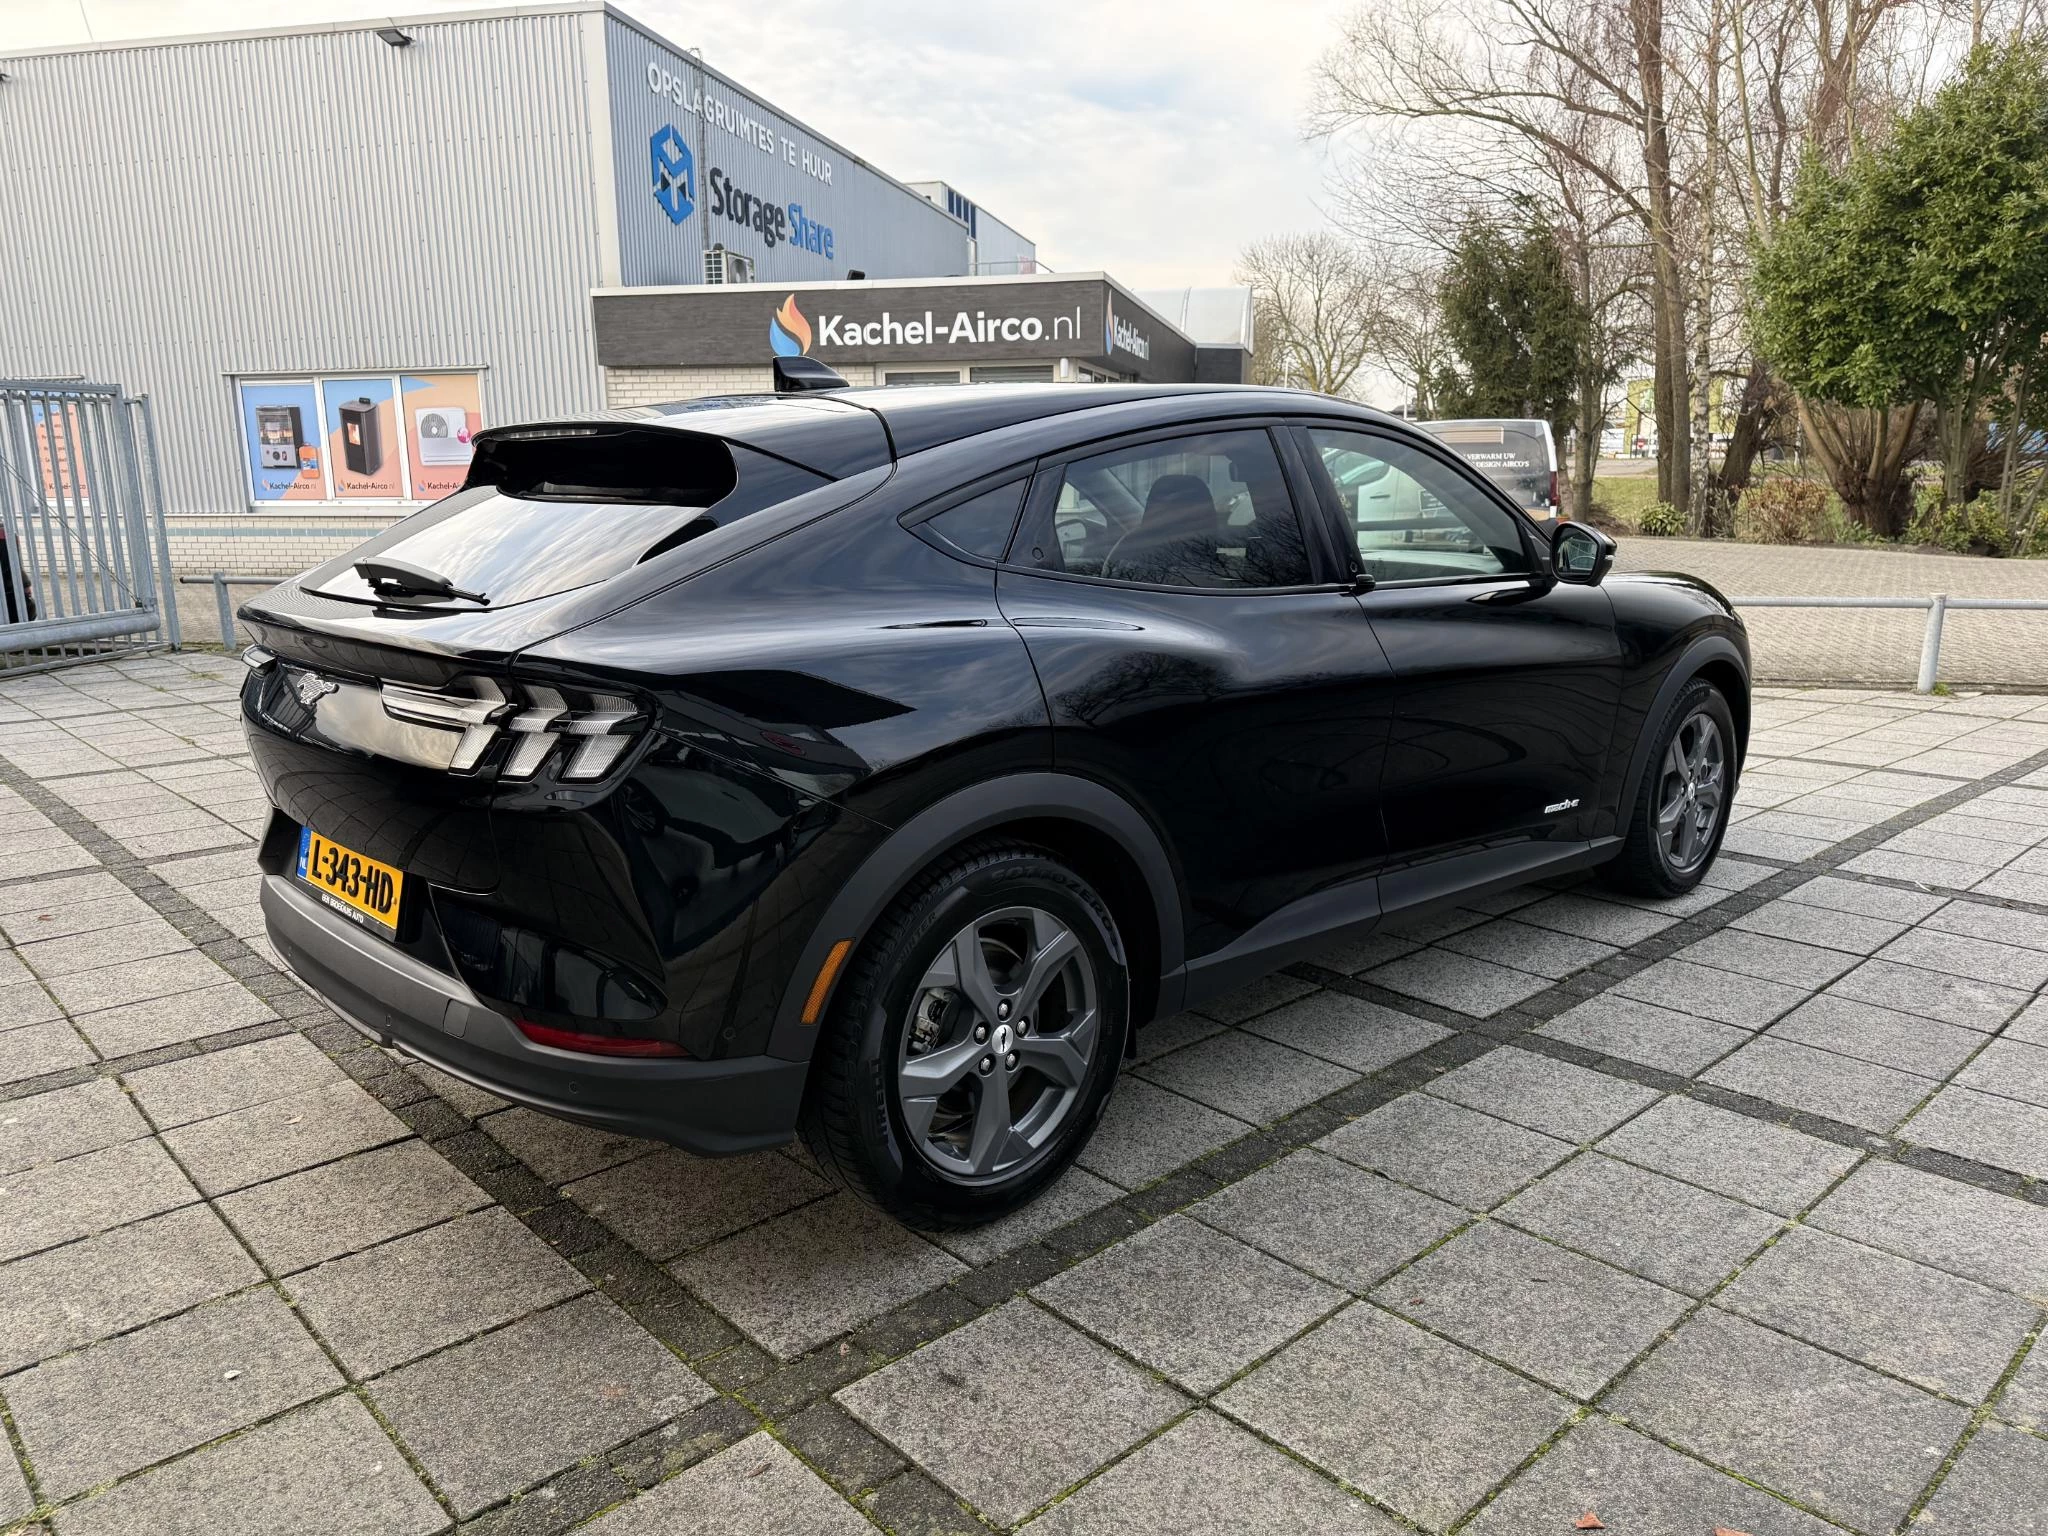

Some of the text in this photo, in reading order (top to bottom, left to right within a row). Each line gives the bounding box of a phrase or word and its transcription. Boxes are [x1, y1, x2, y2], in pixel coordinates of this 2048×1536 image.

[647, 62, 832, 186] OPSLAGRUIMTES TE HUUR
[709, 167, 834, 259] Storage Share
[818, 306, 1081, 347] Kachel-Airco.nl
[1504, 452, 1516, 460] UW
[299, 857, 307, 870] NL
[311, 839, 394, 914] L-343-HD
